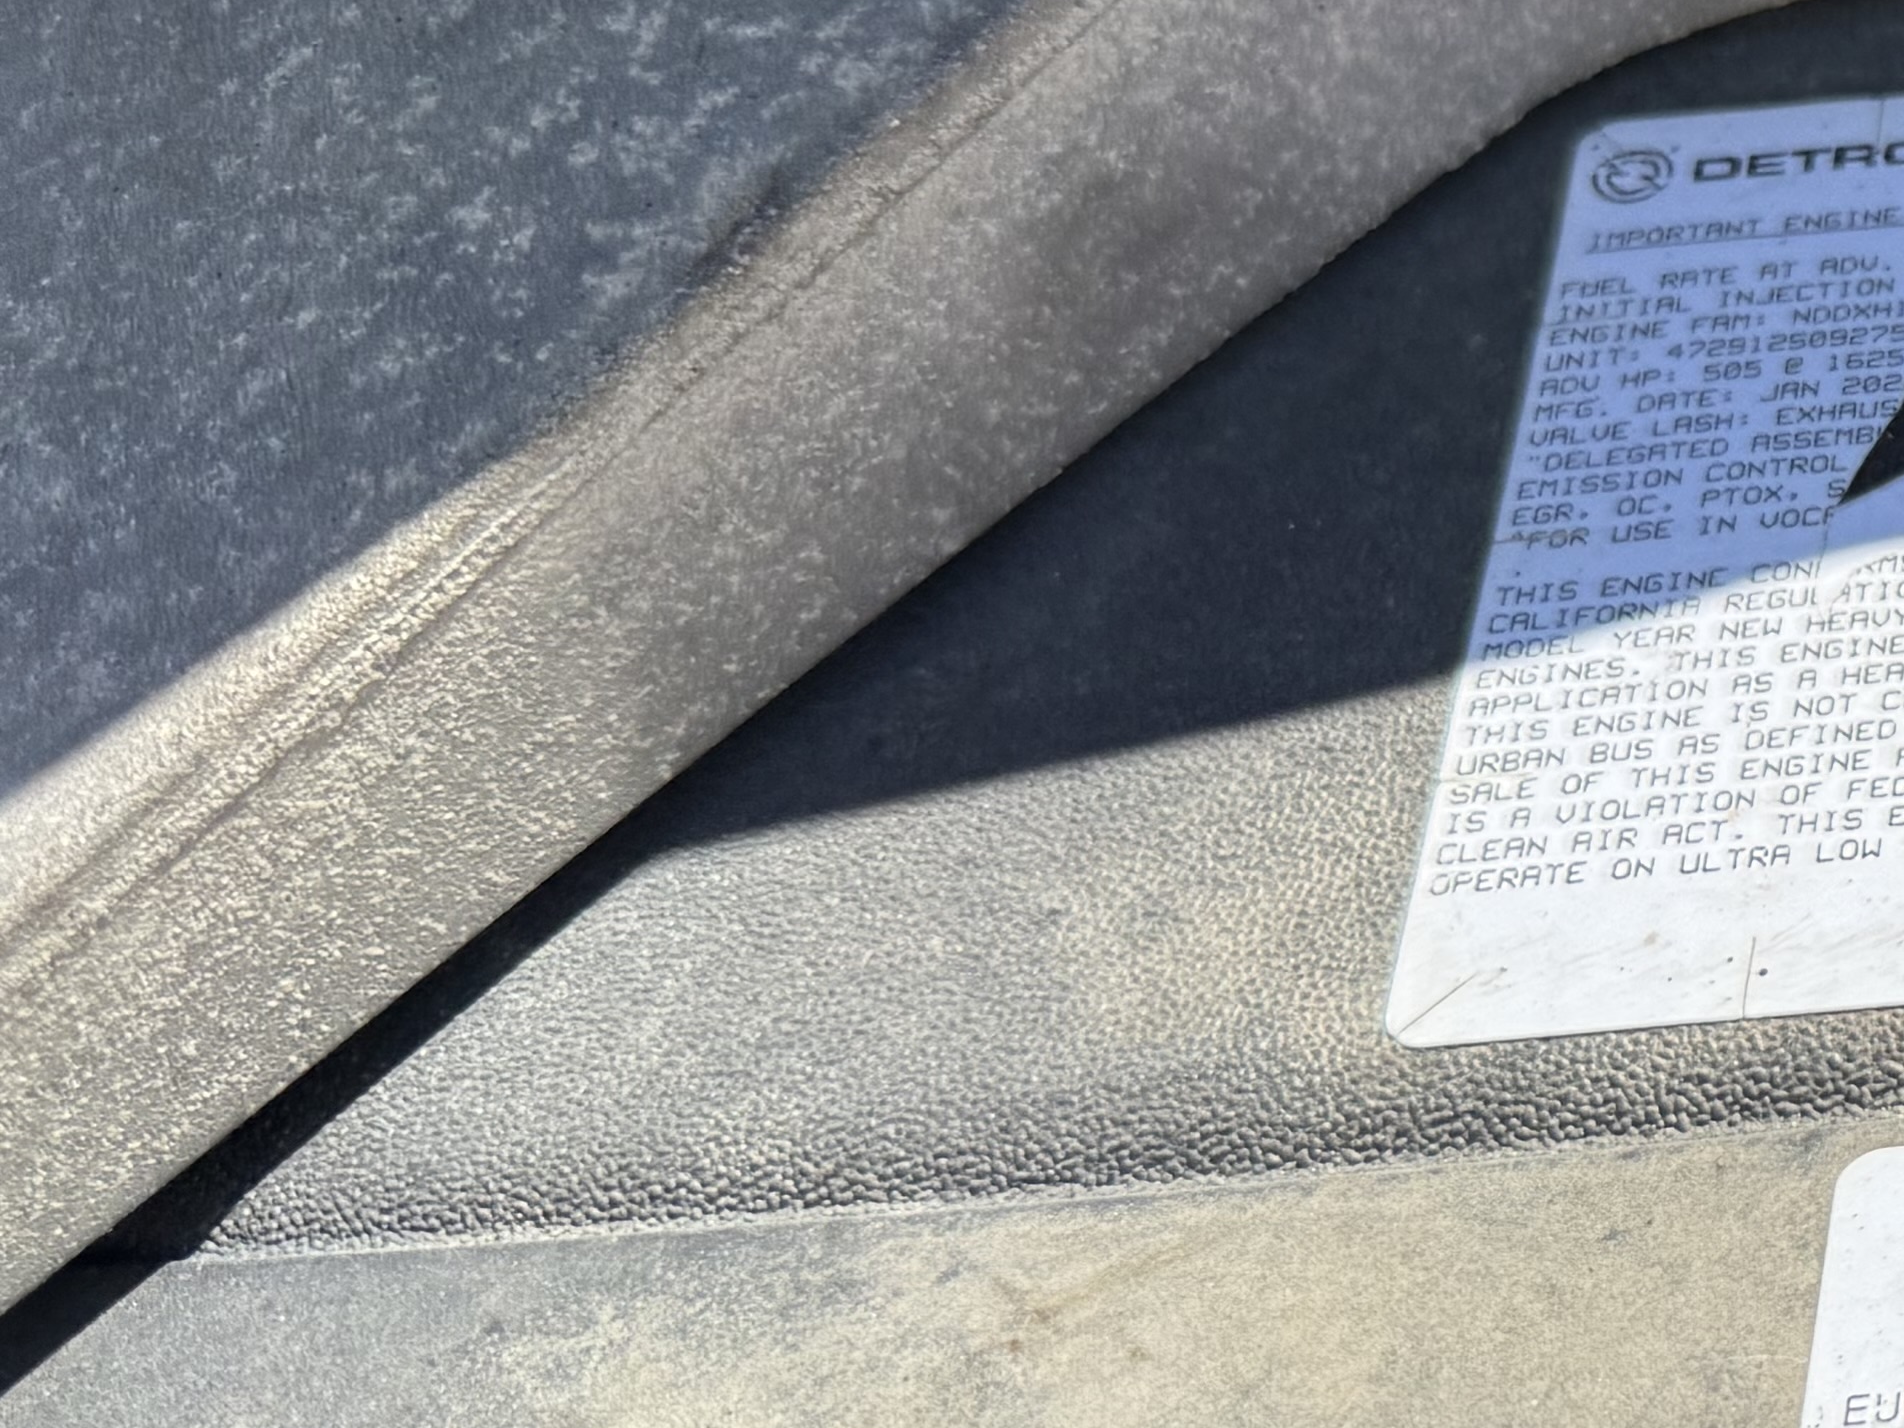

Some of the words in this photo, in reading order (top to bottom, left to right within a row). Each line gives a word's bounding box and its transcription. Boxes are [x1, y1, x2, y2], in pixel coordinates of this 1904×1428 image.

[1589, 219, 1760, 250] IMPORTANT
[1784, 207, 1901, 233] ENGINE
[1558, 276, 1637, 299] FUEL
[1658, 267, 1737, 289] RATE
[1758, 263, 1796, 280] AT
[1818, 254, 1892, 277] ADV.
[1556, 294, 1693, 323] INITIAL
[1719, 277, 1895, 309] INJECTION
[1548, 319, 1669, 347] ENGINE
[1689, 311, 1765, 334] FAM:
[1537, 374, 1600, 397] ADV
[1619, 367, 1676, 388] HP:
[1701, 360, 1763, 382] 505
[1783, 357, 1804, 375] @
[1542, 346, 1640, 372] UNIT:
[1532, 397, 1609, 422] MFG.
[1635, 387, 1733, 413] DATE:
[1759, 379, 1820, 402] JAN
[1527, 421, 1631, 447] VALVE
[1650, 410, 1749, 437] LASH:
[1749, 424, 1882, 454] ASSEMB
[1516, 466, 1684, 499] EMISSION
[1703, 452, 1849, 483] CONTROL
[1610, 519, 1674, 544] USE
[1699, 515, 1737, 536] IN
[1493, 580, 1579, 607] THIS
[1599, 568, 1728, 598] ENGINE
[1486, 597, 1701, 635] CALIFORNIA
[1480, 633, 1585, 661] MODEL
[1610, 624, 1696, 650] YEAR
[1717, 618, 1783, 641] NEW
[1473, 656, 1642, 690] ENGINES.
[1668, 647, 1756, 673] THIS
[1466, 678, 1709, 718] APPLICATION
[1730, 673, 1774, 696] AS
[1795, 669, 1818, 690] A
[1462, 719, 1550, 747] THIS
[1570, 706, 1703, 738] ENGINE
[1729, 701, 1770, 726] IS
[1792, 694, 1857, 719] NOT
[1453, 746, 1567, 777] URBAN
[1586, 739, 1655, 765] BUS
[1676, 734, 1721, 757] AS
[1742, 719, 1898, 752] DEFINED
[1447, 777, 1538, 806] SALE
[1558, 772, 1604, 797] OF
[1627, 763, 1716, 790] THIS
[1737, 750, 1871, 781] ENGINE
[1446, 810, 1488, 835] IS
[1508, 806, 1532, 829] A
[1552, 788, 1756, 827] VIOLATION
[1776, 783, 1822, 807] OF
[1434, 834, 1548, 866] CLEAN
[1570, 827, 1639, 854] AIR
[1660, 818, 1746, 847] ACT.
[1774, 809, 1864, 837] THIS
[1427, 861, 1587, 897] OPERATE
[1609, 855, 1656, 881] ON
[1677, 844, 1792, 876] ULTRA
[1815, 837, 1882, 864] LOW
